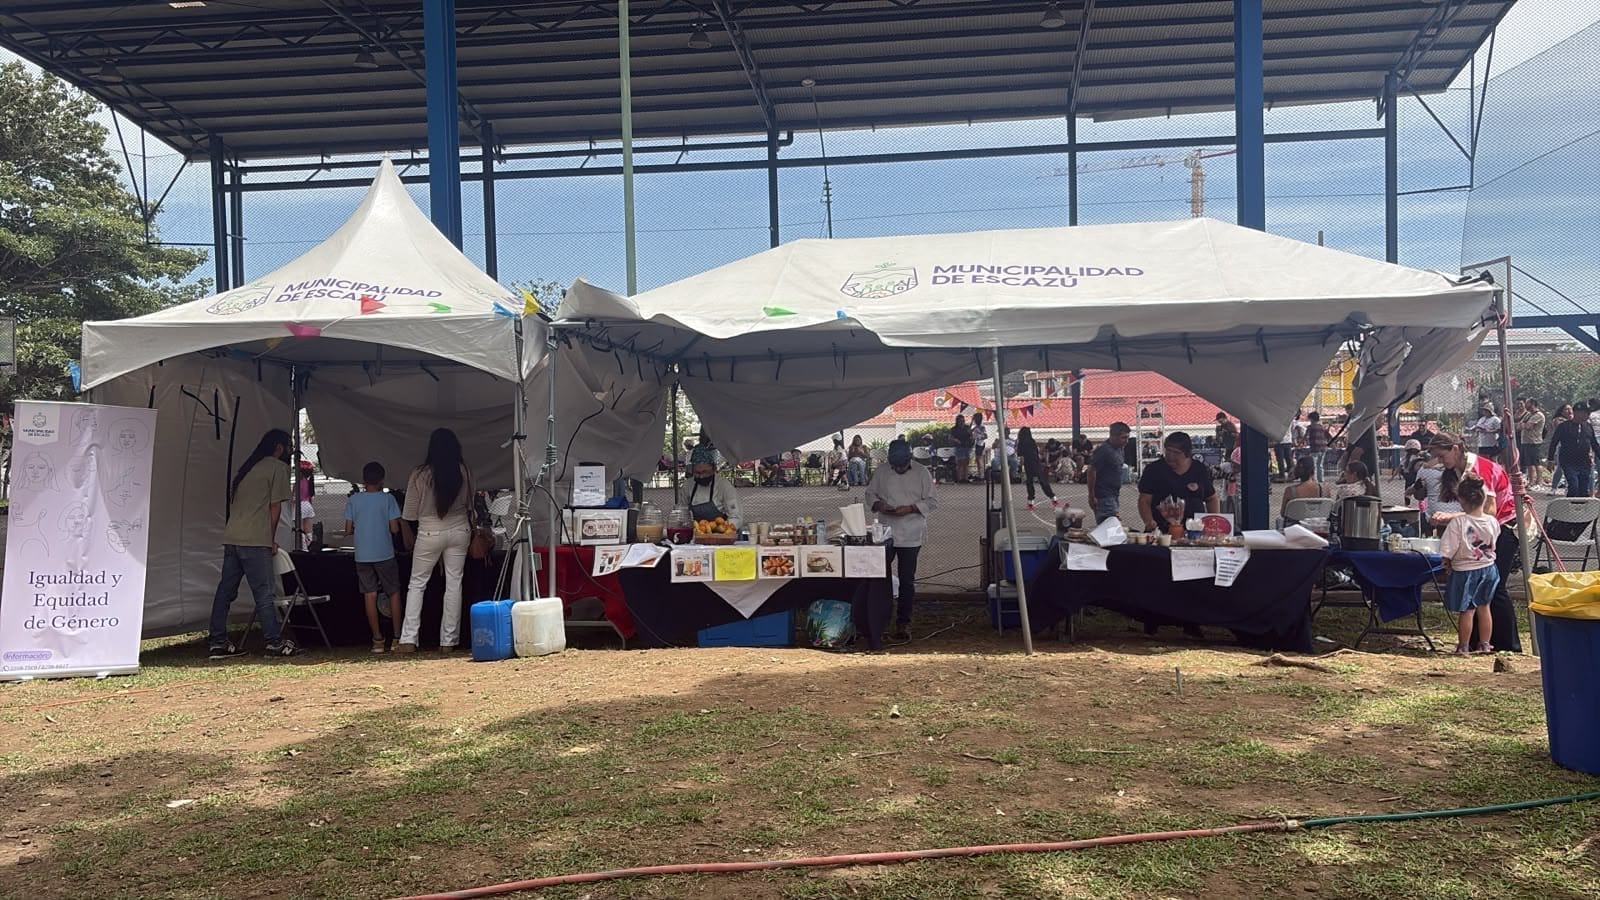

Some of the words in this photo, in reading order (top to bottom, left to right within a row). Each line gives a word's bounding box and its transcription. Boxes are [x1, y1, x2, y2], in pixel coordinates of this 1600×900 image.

[933, 264, 1144, 277] MUNICIPALIDAD
[284, 277, 442, 298] MUNICIPALIDAD
[931, 275, 964, 285] DE
[971, 275, 1078, 288] ESCAZÚ
[275, 291, 304, 303] DE
[28, 569, 106, 588] Igualdad
[111, 574, 123, 588] y
[33, 591, 109, 610] Equidad
[24, 615, 46, 629] de
[51, 614, 119, 629] Género
